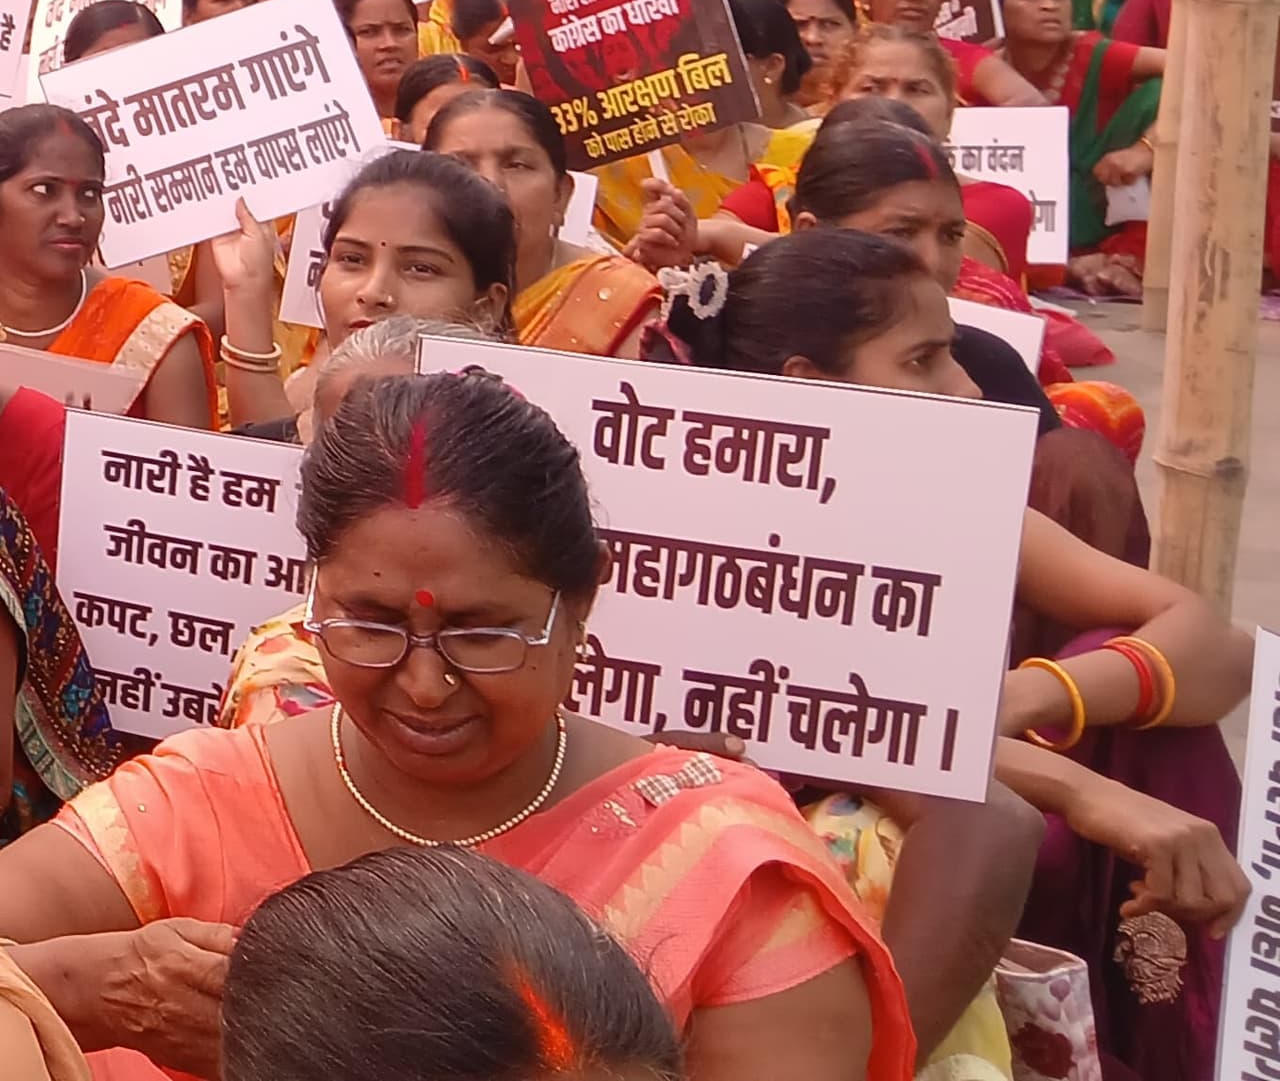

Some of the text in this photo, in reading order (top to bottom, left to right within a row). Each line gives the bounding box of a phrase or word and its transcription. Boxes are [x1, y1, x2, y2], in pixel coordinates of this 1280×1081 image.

[0, 13, 16, 52] है
[547, 13, 602, 53] कांग्रेस
[597, 7, 628, 35] का
[123, 24, 331, 136] मातरम गाएंगे
[550, 53, 732, 136] 33% आरक्षण बिल
[102, 100, 360, 225] नारी सम्मान हम वापस लाएंगे
[584, 101, 717, 159] को पास होने से रोका
[961, 138, 1025, 173] का वंदन
[592, 383, 837, 505] वोट हमारा,
[101, 449, 280, 513] नारी है हम
[103, 520, 203, 575] जीवन
[207, 543, 258, 585] का
[73, 591, 239, 663] कपट, छल,
[871, 565, 942, 638] का
[92, 667, 162, 712] नहीं
[563, 633, 928, 767] लेगा, नहीं चलेगा
